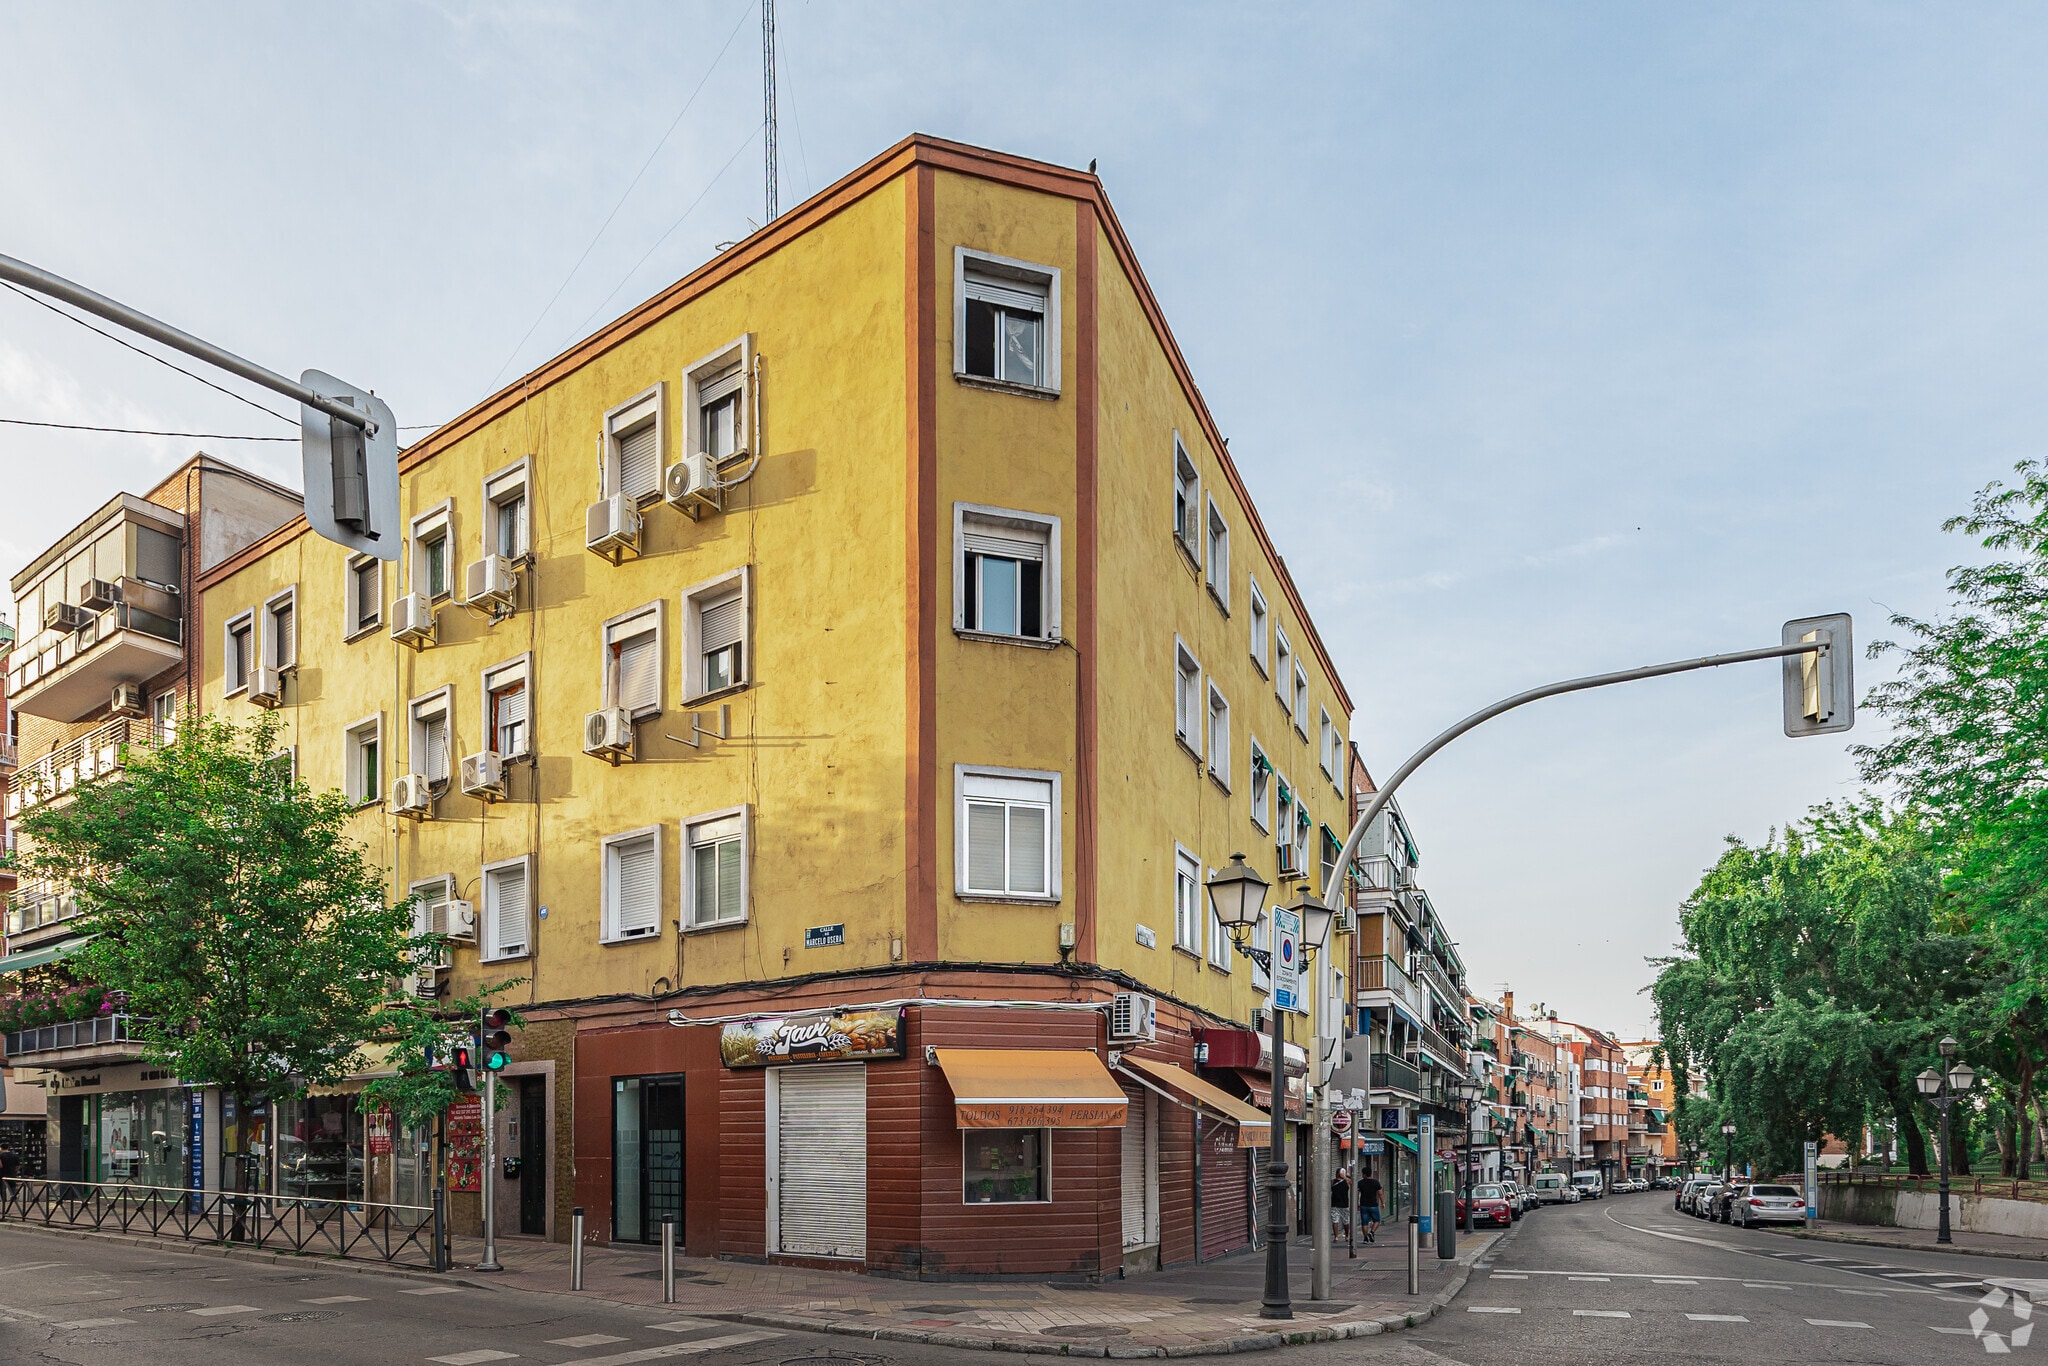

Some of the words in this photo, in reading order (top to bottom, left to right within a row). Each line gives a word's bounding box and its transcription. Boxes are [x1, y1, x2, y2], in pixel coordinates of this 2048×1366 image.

[806, 937, 826, 946] MARCELO
[827, 935, 842, 944] USERA
[775, 1017, 831, 1054] Javi
[1009, 1105, 1025, 1114] 918
[1027, 1105, 1044, 1114] 264
[1046, 1105, 1064, 1114] 394
[1069, 1109, 1123, 1120] PERSIANAS
[960, 1110, 1001, 1121] TOLDOS
[1007, 1117, 1023, 1126] 673
[1026, 1117, 1043, 1126] 696
[1045, 1117, 1061, 1126] 395
